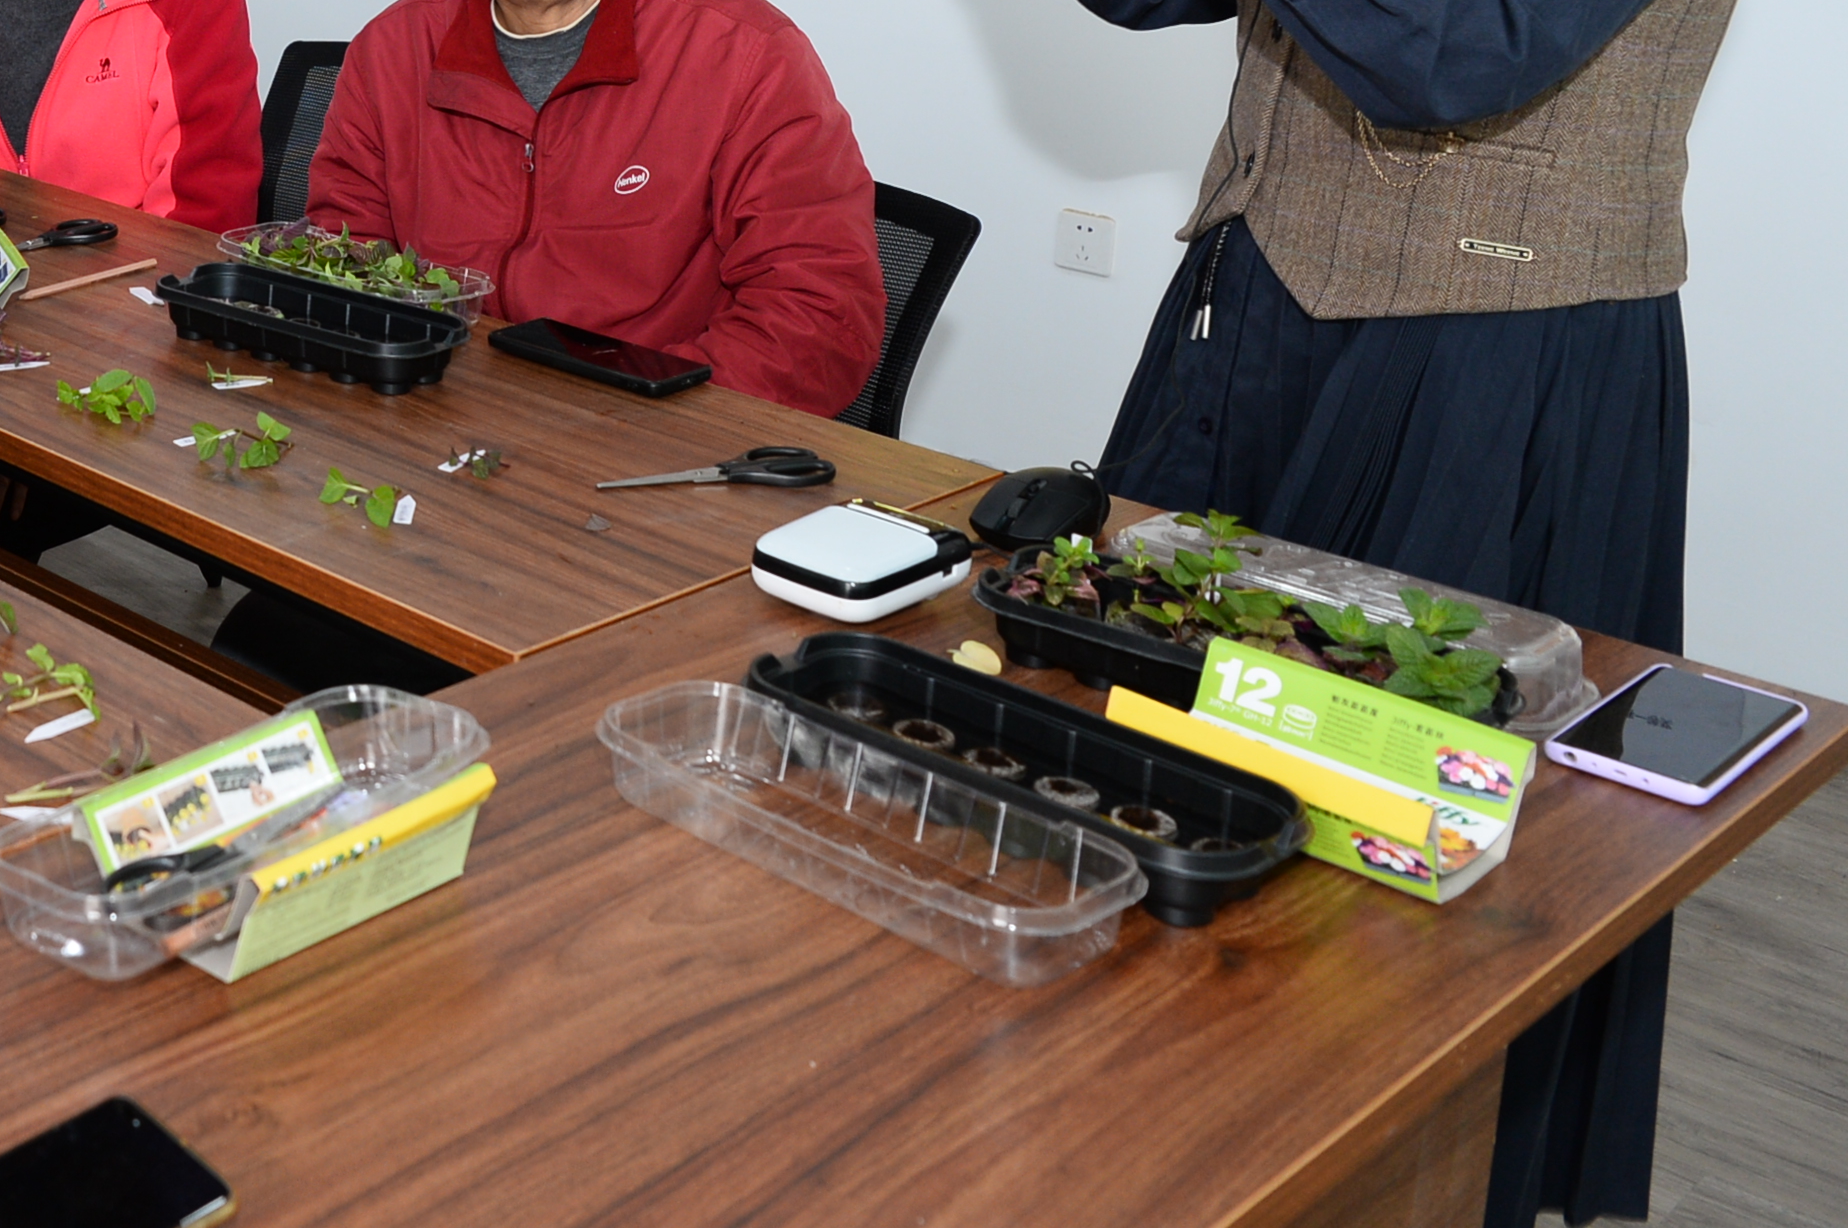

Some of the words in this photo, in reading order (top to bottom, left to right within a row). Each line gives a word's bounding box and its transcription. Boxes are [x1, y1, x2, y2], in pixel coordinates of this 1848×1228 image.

[85, 70, 120, 83] CAMEL
[617, 172, 646, 188] Henkel
[1214, 656, 1283, 718] 12
